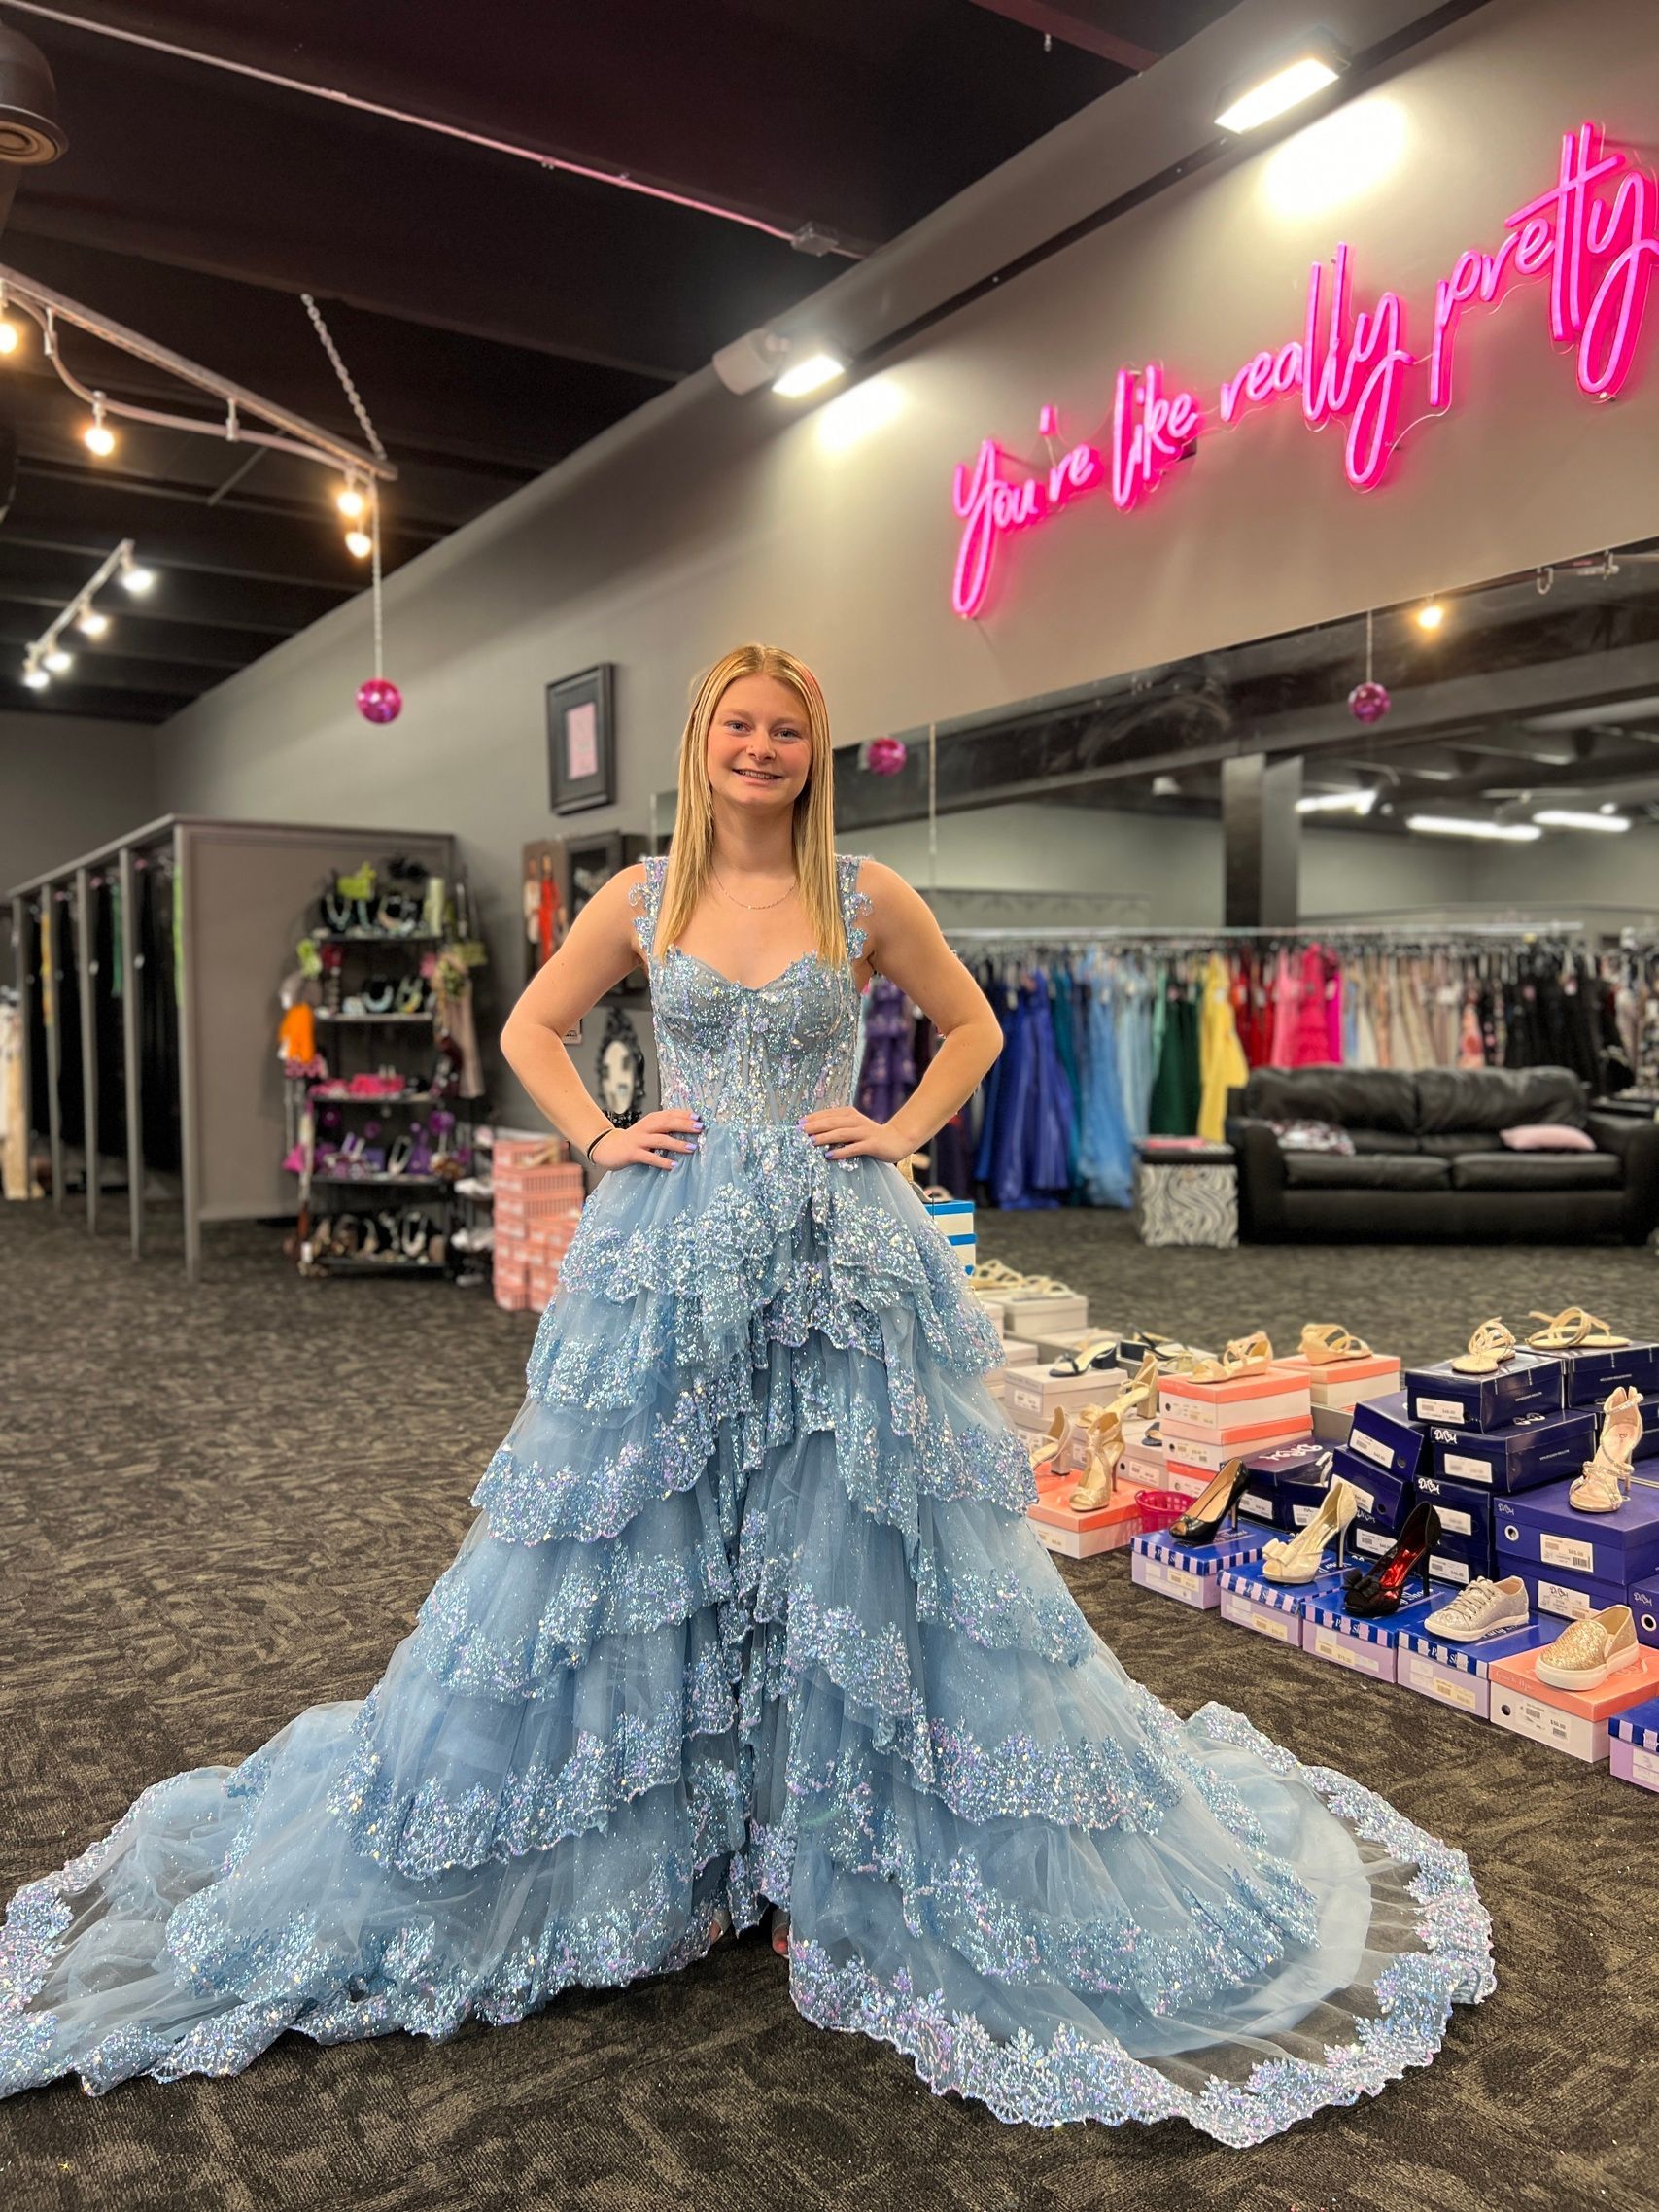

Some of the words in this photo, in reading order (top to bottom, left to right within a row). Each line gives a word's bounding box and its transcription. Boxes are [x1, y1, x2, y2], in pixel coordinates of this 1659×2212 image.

[952, 406, 1094, 617] You're
[1112, 363, 1199, 507] like
[1221, 241, 1416, 487] really
[1430, 122, 1659, 407] pretty
